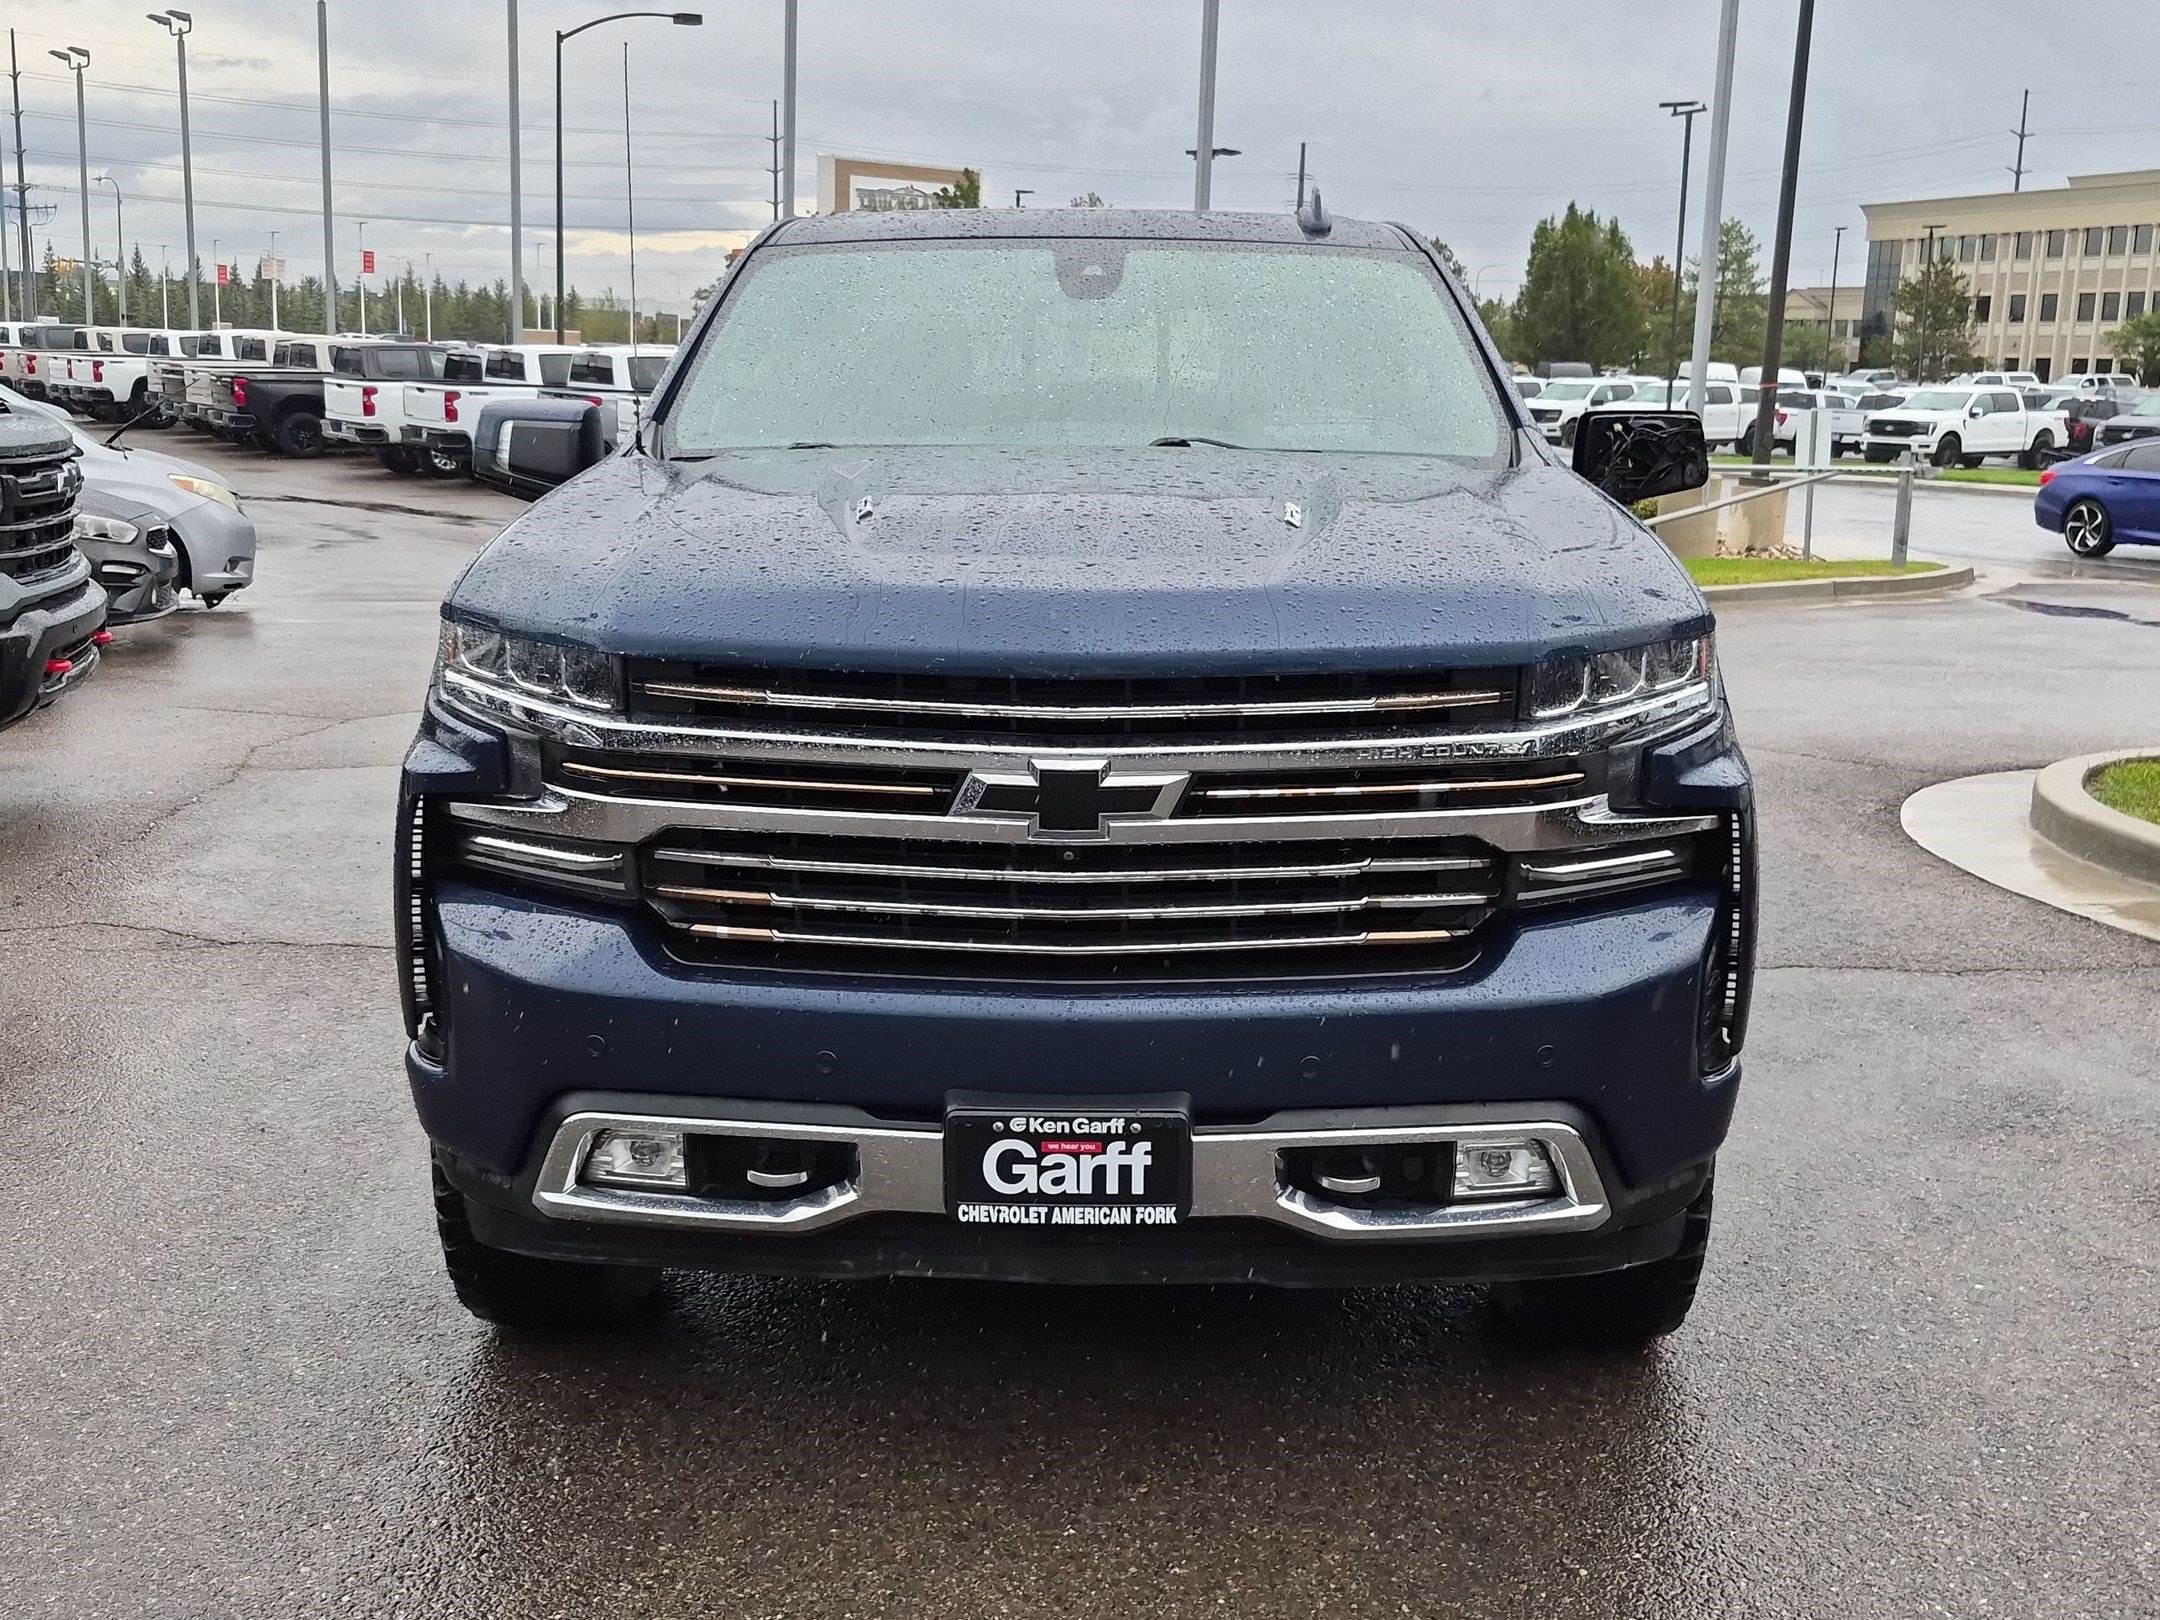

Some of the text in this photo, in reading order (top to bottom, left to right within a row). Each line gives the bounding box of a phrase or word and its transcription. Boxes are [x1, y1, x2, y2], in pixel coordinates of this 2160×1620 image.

[1421, 741, 1535, 758] COUNTRY
[1029, 1117, 1125, 1134] Ken Garff
[1060, 1142, 1079, 1150] hear
[1080, 1143, 1096, 1151] you
[982, 1138, 1152, 1195] Garff
[958, 1204, 1177, 1225] CHEVROLET AMERICAN FORK
